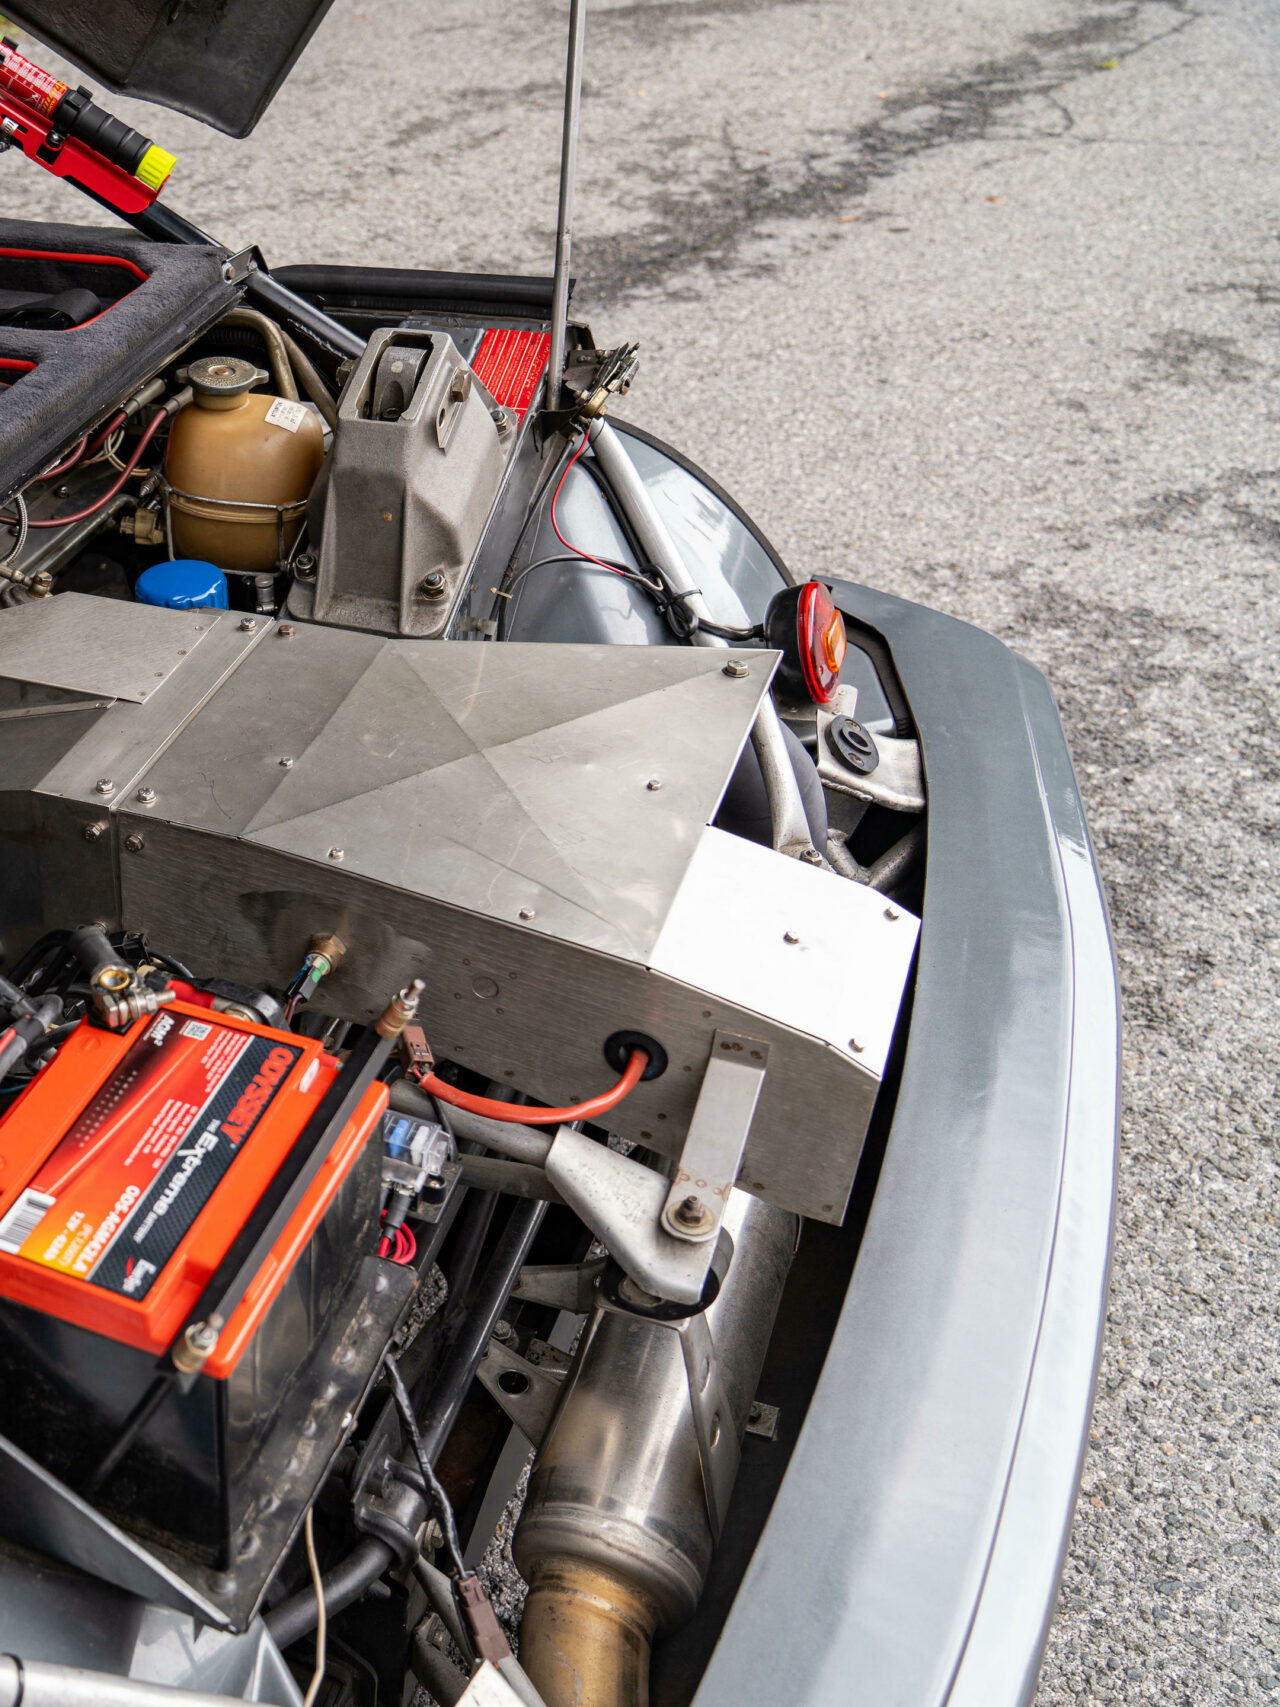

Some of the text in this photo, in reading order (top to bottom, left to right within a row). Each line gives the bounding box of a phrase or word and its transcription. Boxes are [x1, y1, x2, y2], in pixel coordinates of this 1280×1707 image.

[206, 1118, 221, 1132] THE
[220, 1047, 294, 1144] ODYSSEY
[153, 1130, 219, 1217] Extreme
